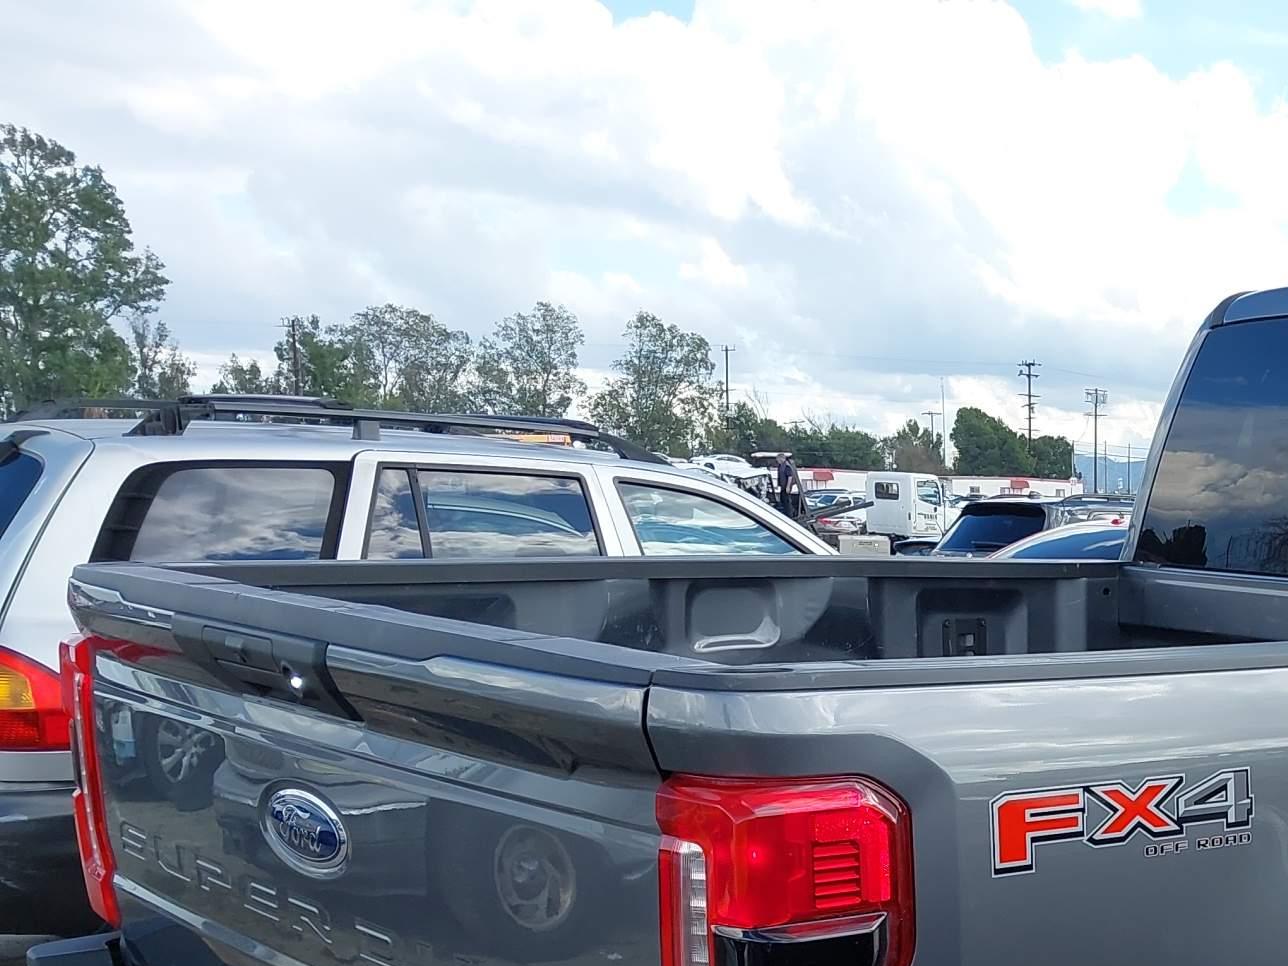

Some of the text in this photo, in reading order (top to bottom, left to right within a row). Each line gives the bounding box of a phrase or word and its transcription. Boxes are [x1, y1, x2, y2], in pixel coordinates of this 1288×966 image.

[278, 803, 322, 853] Ford
[990, 766, 1254, 878] FX4
[1144, 831, 1253, 858] OFF ROAD
[119, 819, 333, 945] SUPER
